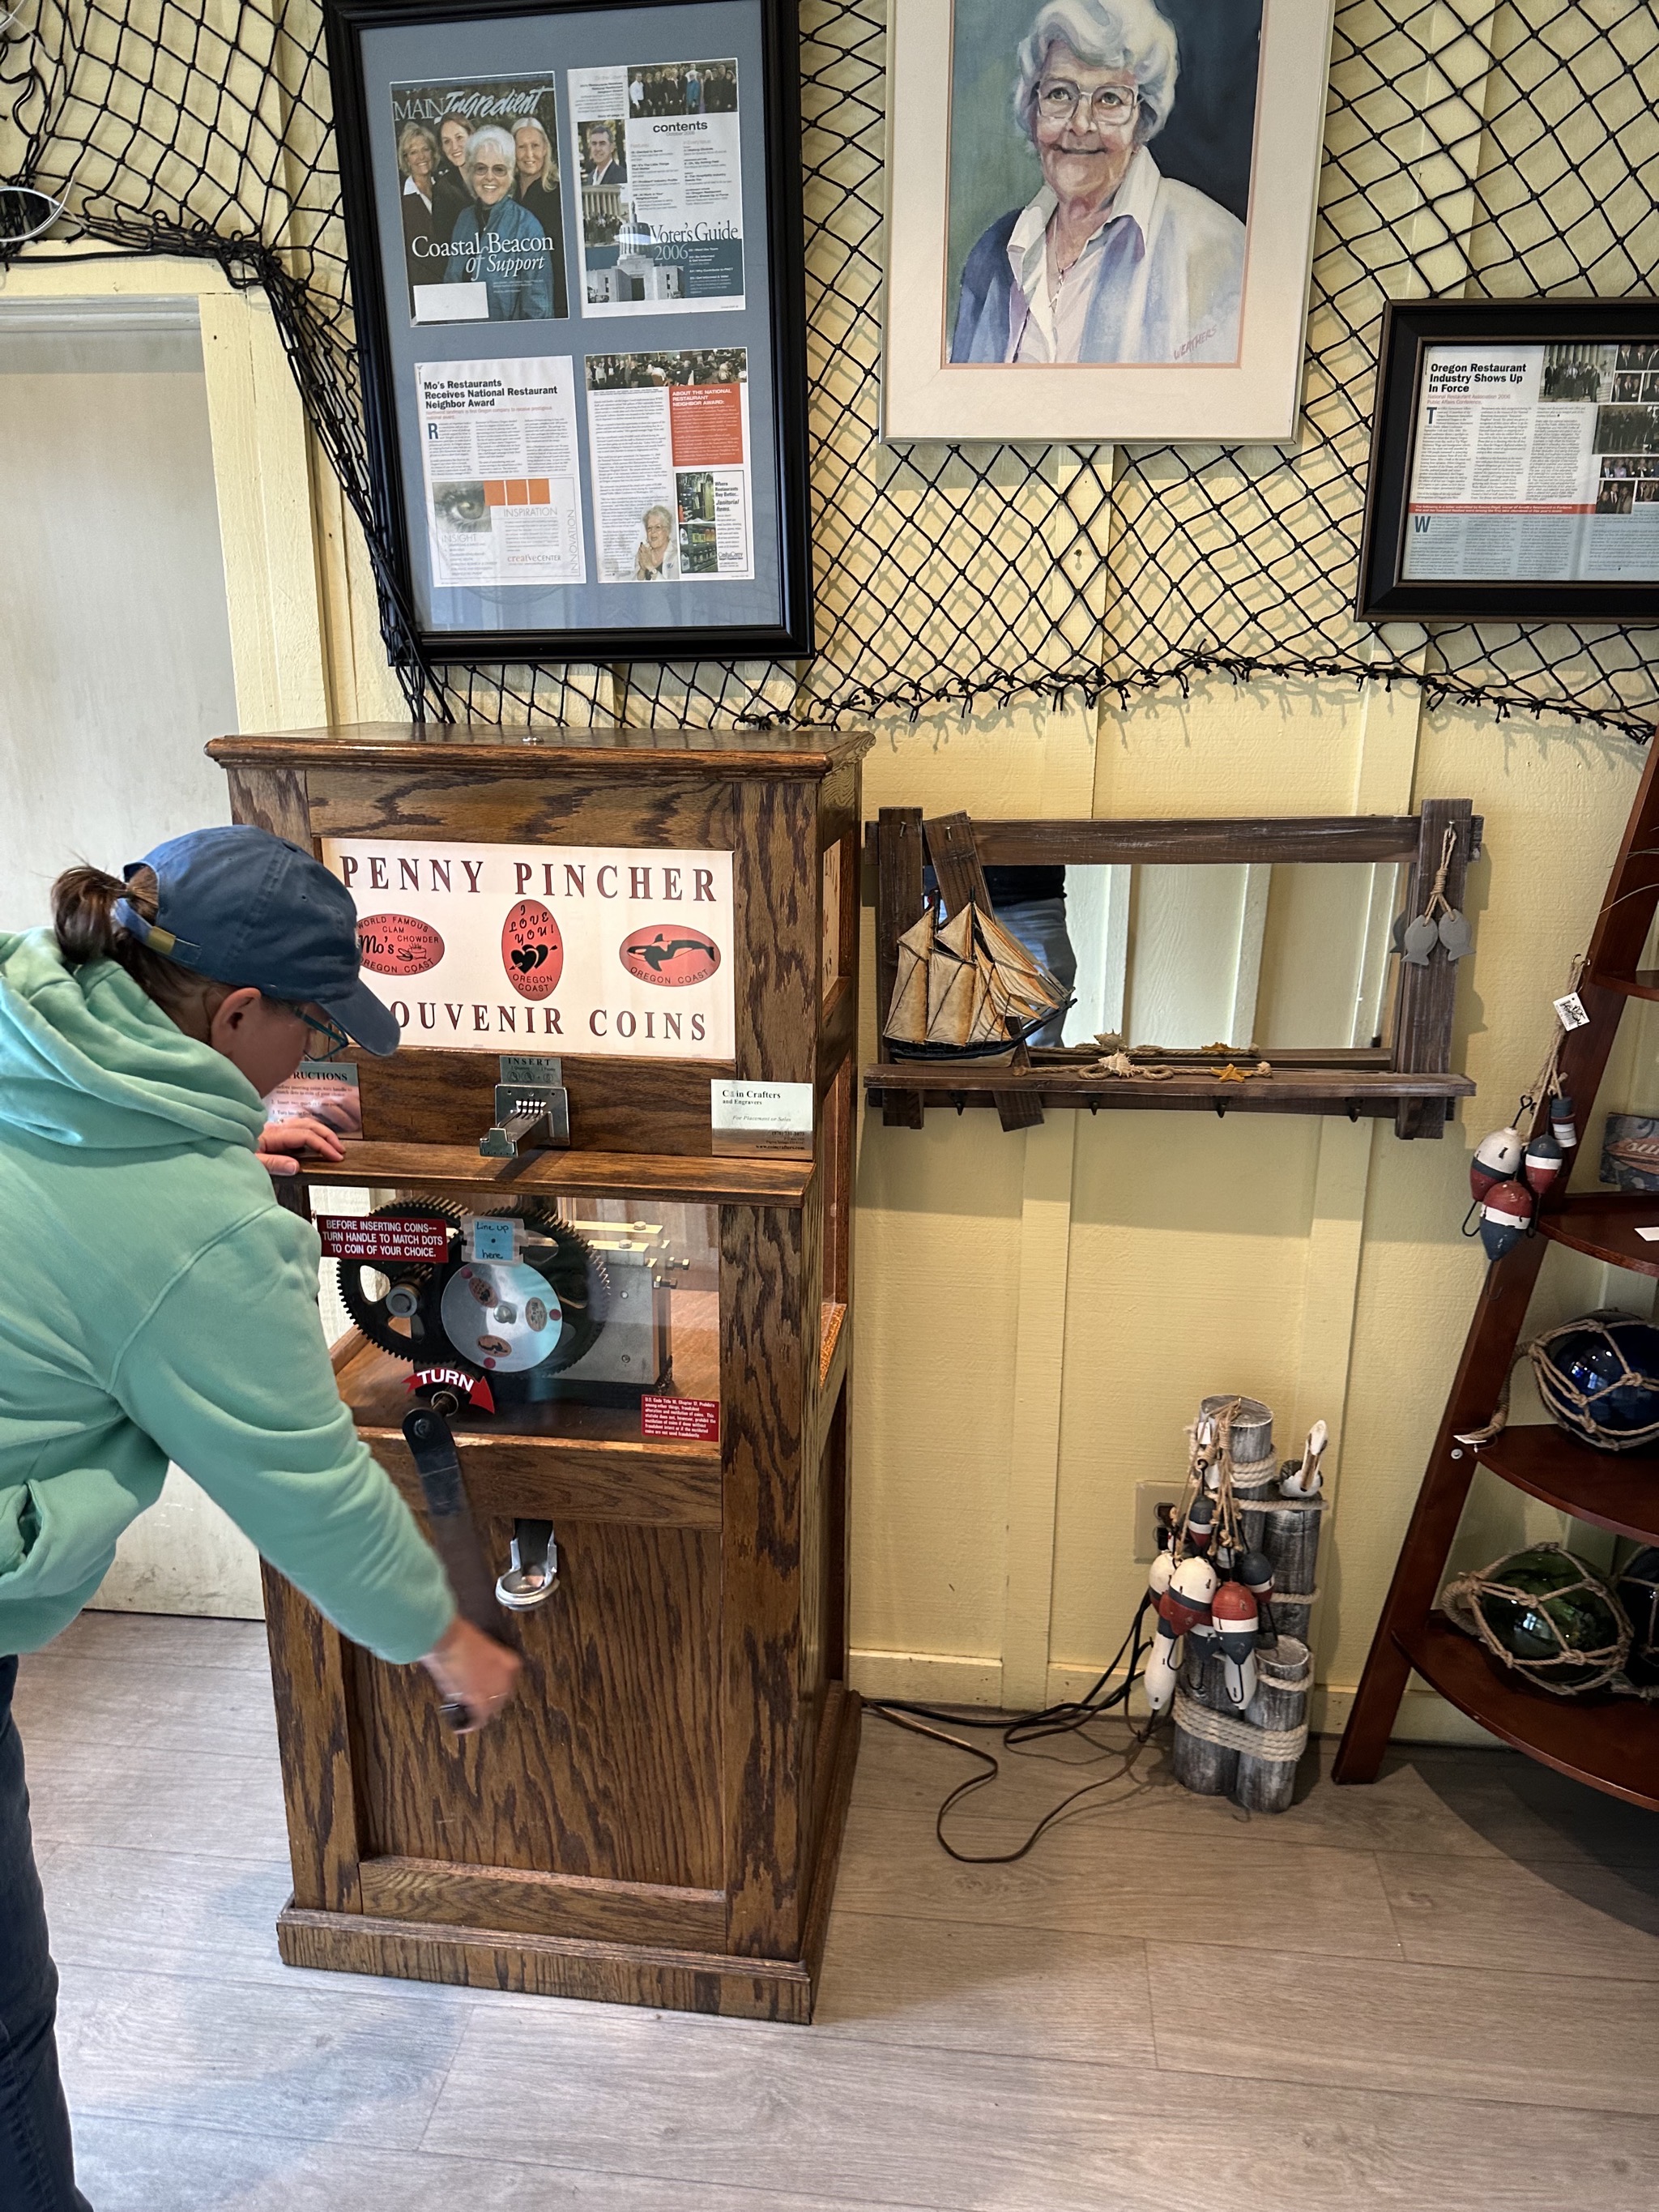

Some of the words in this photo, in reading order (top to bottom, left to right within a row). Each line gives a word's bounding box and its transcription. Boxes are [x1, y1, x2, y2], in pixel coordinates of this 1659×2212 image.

[393, 97, 446, 121] MAIN
[434, 87, 554, 124] Ingredient
[653, 121, 708, 133] contents
[650, 223, 693, 243] Voter's
[695, 220, 738, 241] Guide
[412, 233, 481, 258] Coastal
[487, 232, 554, 254] Beacon
[655, 243, 689, 261] 2006
[466, 246, 484, 281] of
[487, 254, 544, 279] Support
[1174, 325, 1217, 360] WEATHERS
[1431, 363, 1467, 374] Oregon
[1470, 363, 1527, 372] Restaurant
[424, 381, 445, 390] Mo's
[447, 379, 502, 389] Restaurants
[1430, 374, 1472, 384] Industry
[1473, 374, 1507, 382] Shows
[1509, 374, 1523, 384] Up
[425, 390, 465, 399] Receives
[467, 387, 505, 398] National
[507, 386, 558, 396] Restaurant
[1428, 384, 1438, 392] In
[1441, 384, 1469, 392] Force
[426, 399, 465, 410] Neighbor
[467, 398, 495, 407] Award
[1427, 407, 1437, 425] T
[428, 423, 439, 439] R
[504, 506, 558, 518] INSPIRATION
[1414, 515, 1431, 532] W
[441, 533, 477, 543] INSIGHT
[567, 509, 578, 574] INNOVATION
[339, 855, 484, 894] PENNY
[513, 861, 717, 902] PINCHER
[357, 916, 386, 929] WORLD
[393, 916, 429, 933] FAMOUS
[509, 912, 549, 933] LOVE
[397, 935, 439, 943] CHOWDER
[514, 925, 554, 946] YOU!
[359, 934, 394, 954] Mo's
[404, 958, 434, 973] COAST
[513, 974, 553, 984] OREGON
[630, 967, 671, 984] OREGON
[677, 968, 709, 984] COAST
[518, 983, 549, 992] COAST
[390, 1001, 564, 1035] OUVENIR
[589, 1009, 706, 1041] COINS
[508, 1057, 551, 1065] INSERT
[292, 1071, 348, 1081] RUCTIONS
[746, 1090, 781, 1099] Crafters
[326, 1219, 357, 1230] BEFORE
[360, 1221, 401, 1232] INSERTING
[476, 1221, 494, 1231] Line
[497, 1225, 509, 1234] up
[322, 1231, 343, 1241] TURN
[346, 1232, 377, 1243] HANDLE
[379, 1233, 390, 1243] TO
[392, 1234, 419, 1245] MATCH
[421, 1236, 443, 1245] DOTS
[331, 1243, 342, 1253] TO
[344, 1244, 364, 1254] COIN
[366, 1245, 377, 1254] OF
[380, 1245, 402, 1256] YOUR
[403, 1247, 437, 1257] CHOICE.
[482, 1249, 503, 1259] here
[416, 1369, 475, 1392] TURN
